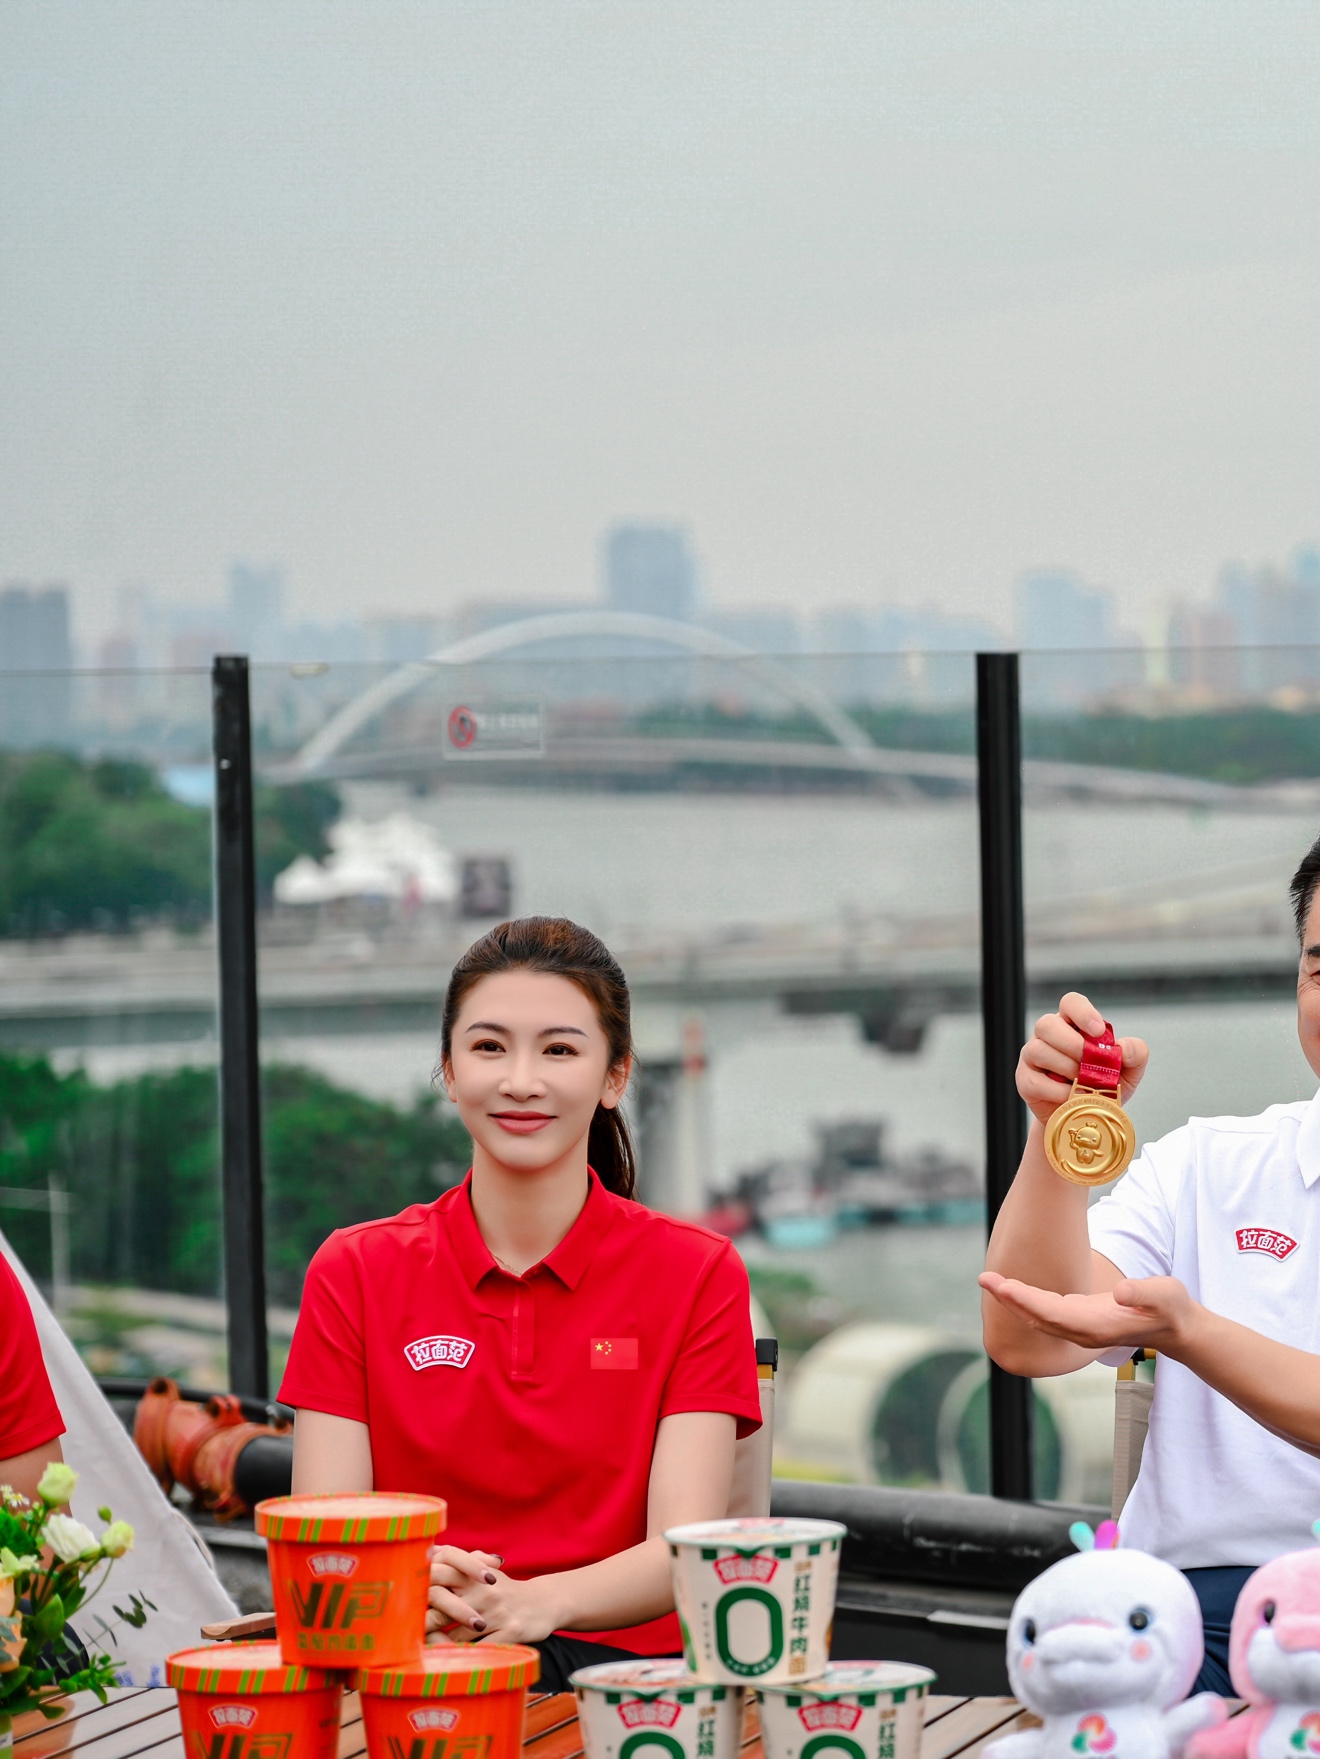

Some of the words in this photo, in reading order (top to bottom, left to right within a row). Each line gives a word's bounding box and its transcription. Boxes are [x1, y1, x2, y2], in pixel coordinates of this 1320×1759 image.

[1241, 1229, 1293, 1255] 拉面范
[411, 1339, 468, 1365] 拉面范
[287, 1580, 394, 1630] VIP
